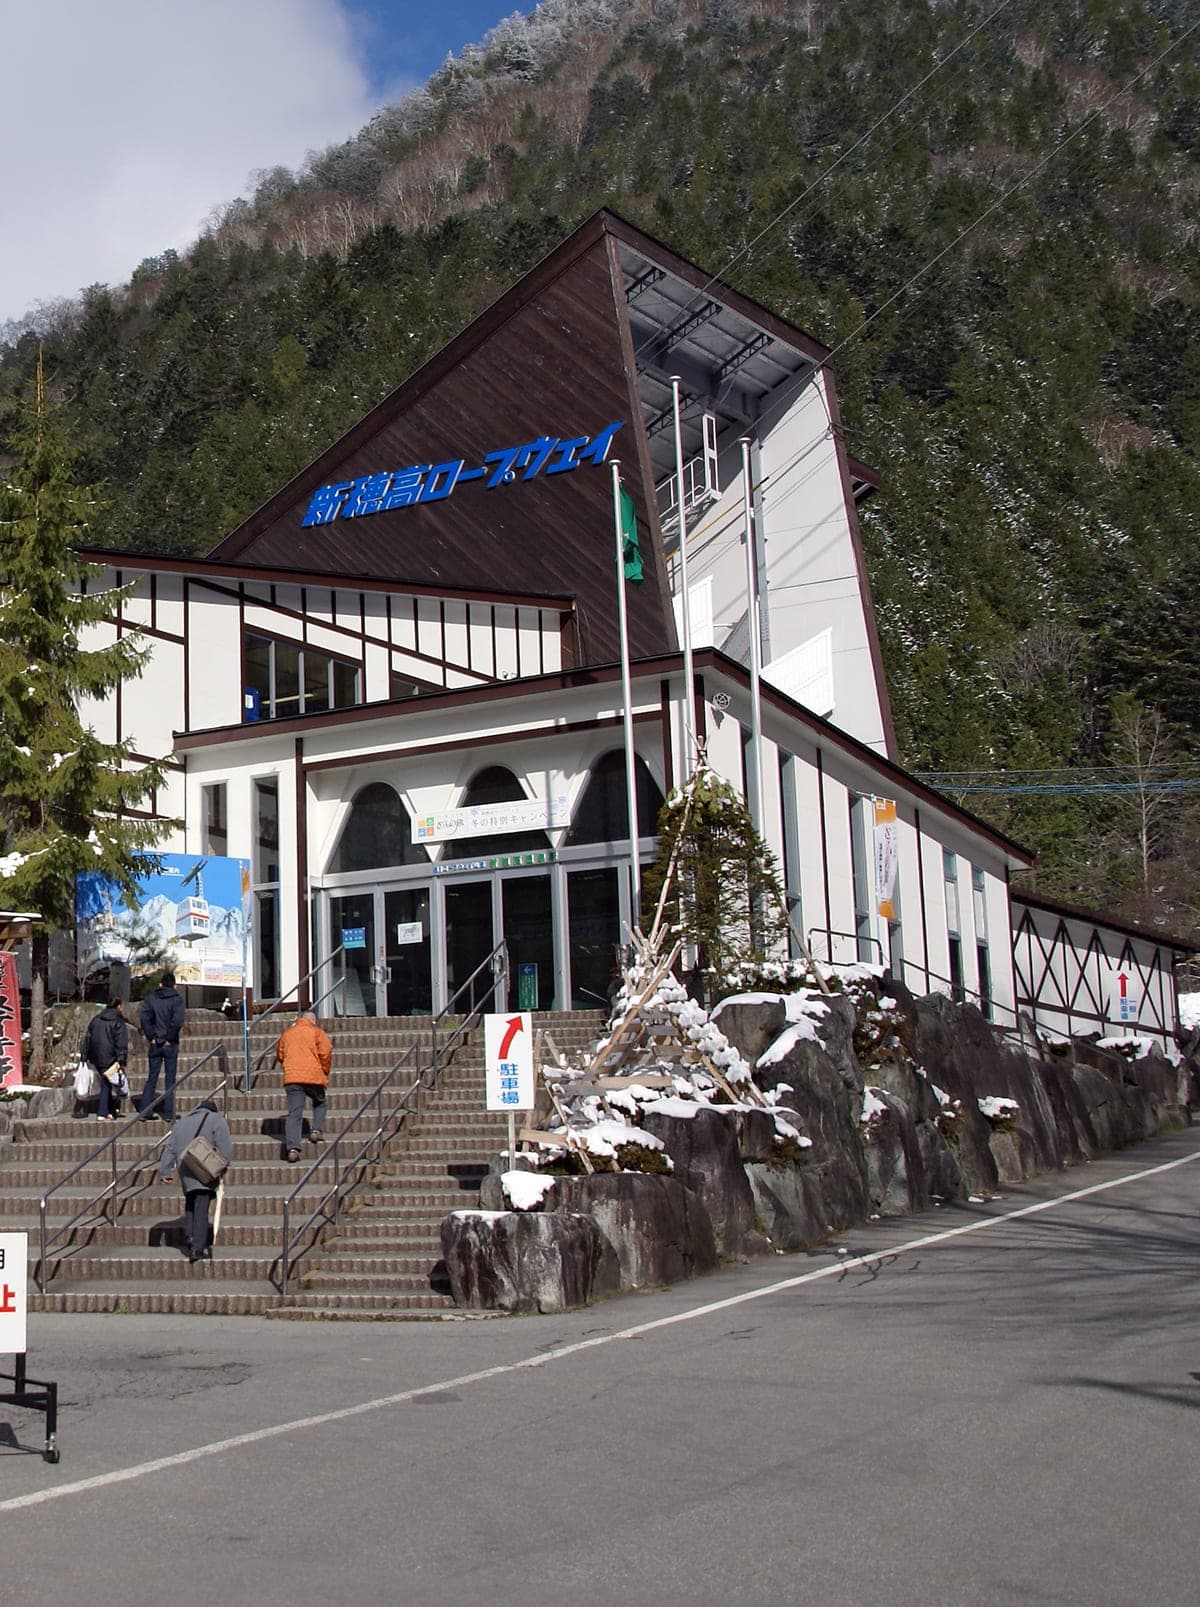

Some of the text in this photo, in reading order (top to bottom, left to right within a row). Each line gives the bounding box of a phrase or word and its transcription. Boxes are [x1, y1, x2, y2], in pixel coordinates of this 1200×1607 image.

[301, 421, 624, 527] 新穂高ロープウェイ
[500, 1063, 520, 1104] 駐車場
